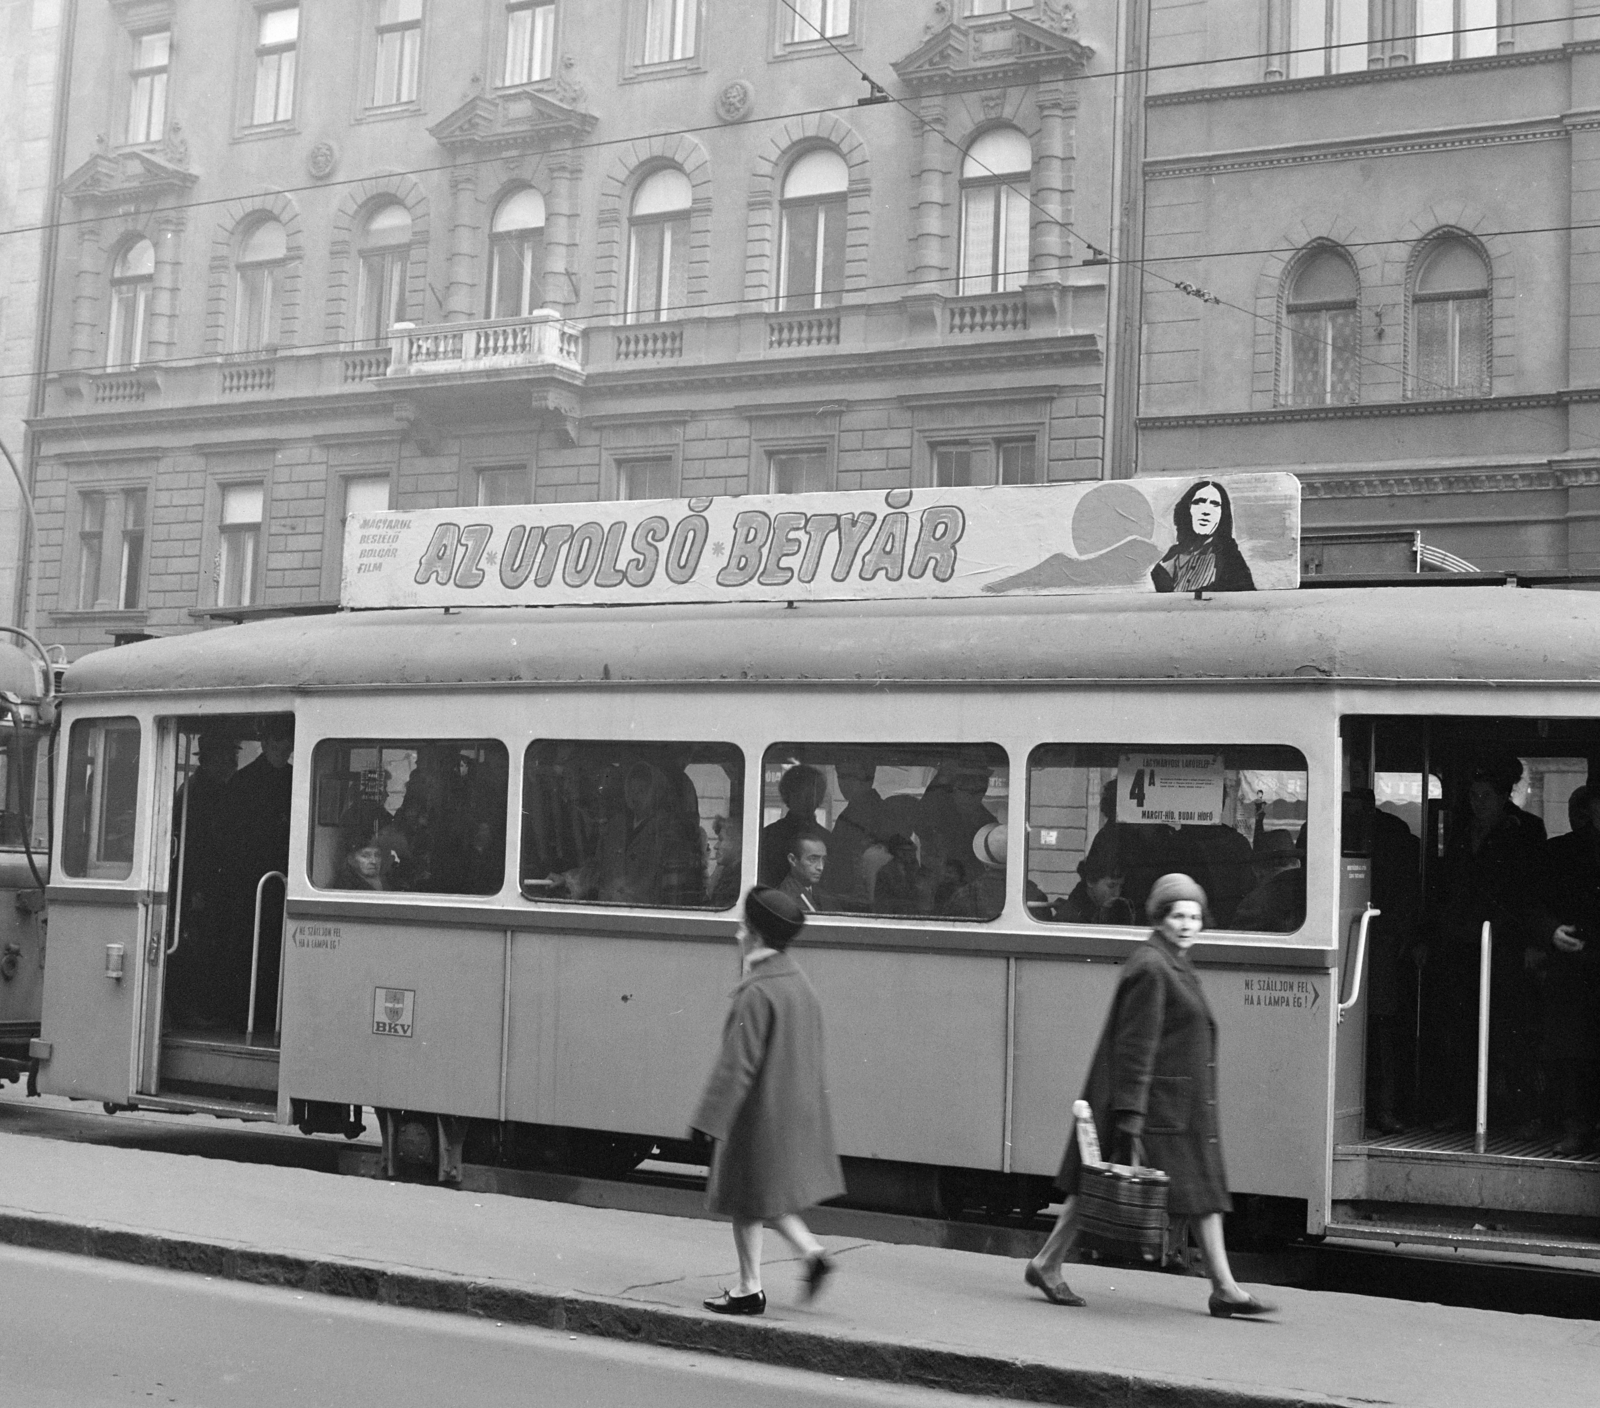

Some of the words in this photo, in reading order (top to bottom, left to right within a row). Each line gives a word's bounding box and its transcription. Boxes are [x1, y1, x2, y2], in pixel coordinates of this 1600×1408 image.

[359, 518, 412, 530] MAGYARUL
[414, 522, 493, 588] AZ
[499, 497, 713, 589] UTOLSÓ
[716, 488, 966, 587] BETYÁR
[357, 562, 383, 574] FILM
[1129, 769, 1145, 807] 4
[1178, 811, 1196, 821] BUDAI
[1244, 979, 1254, 991] NE
[1257, 976, 1294, 992] SZÁLLJON
[1244, 994, 1255, 1006] HA
[1257, 995, 1261, 1006] A
[1264, 992, 1290, 1007] LÁMPA
[375, 1021, 411, 1035] BKV
